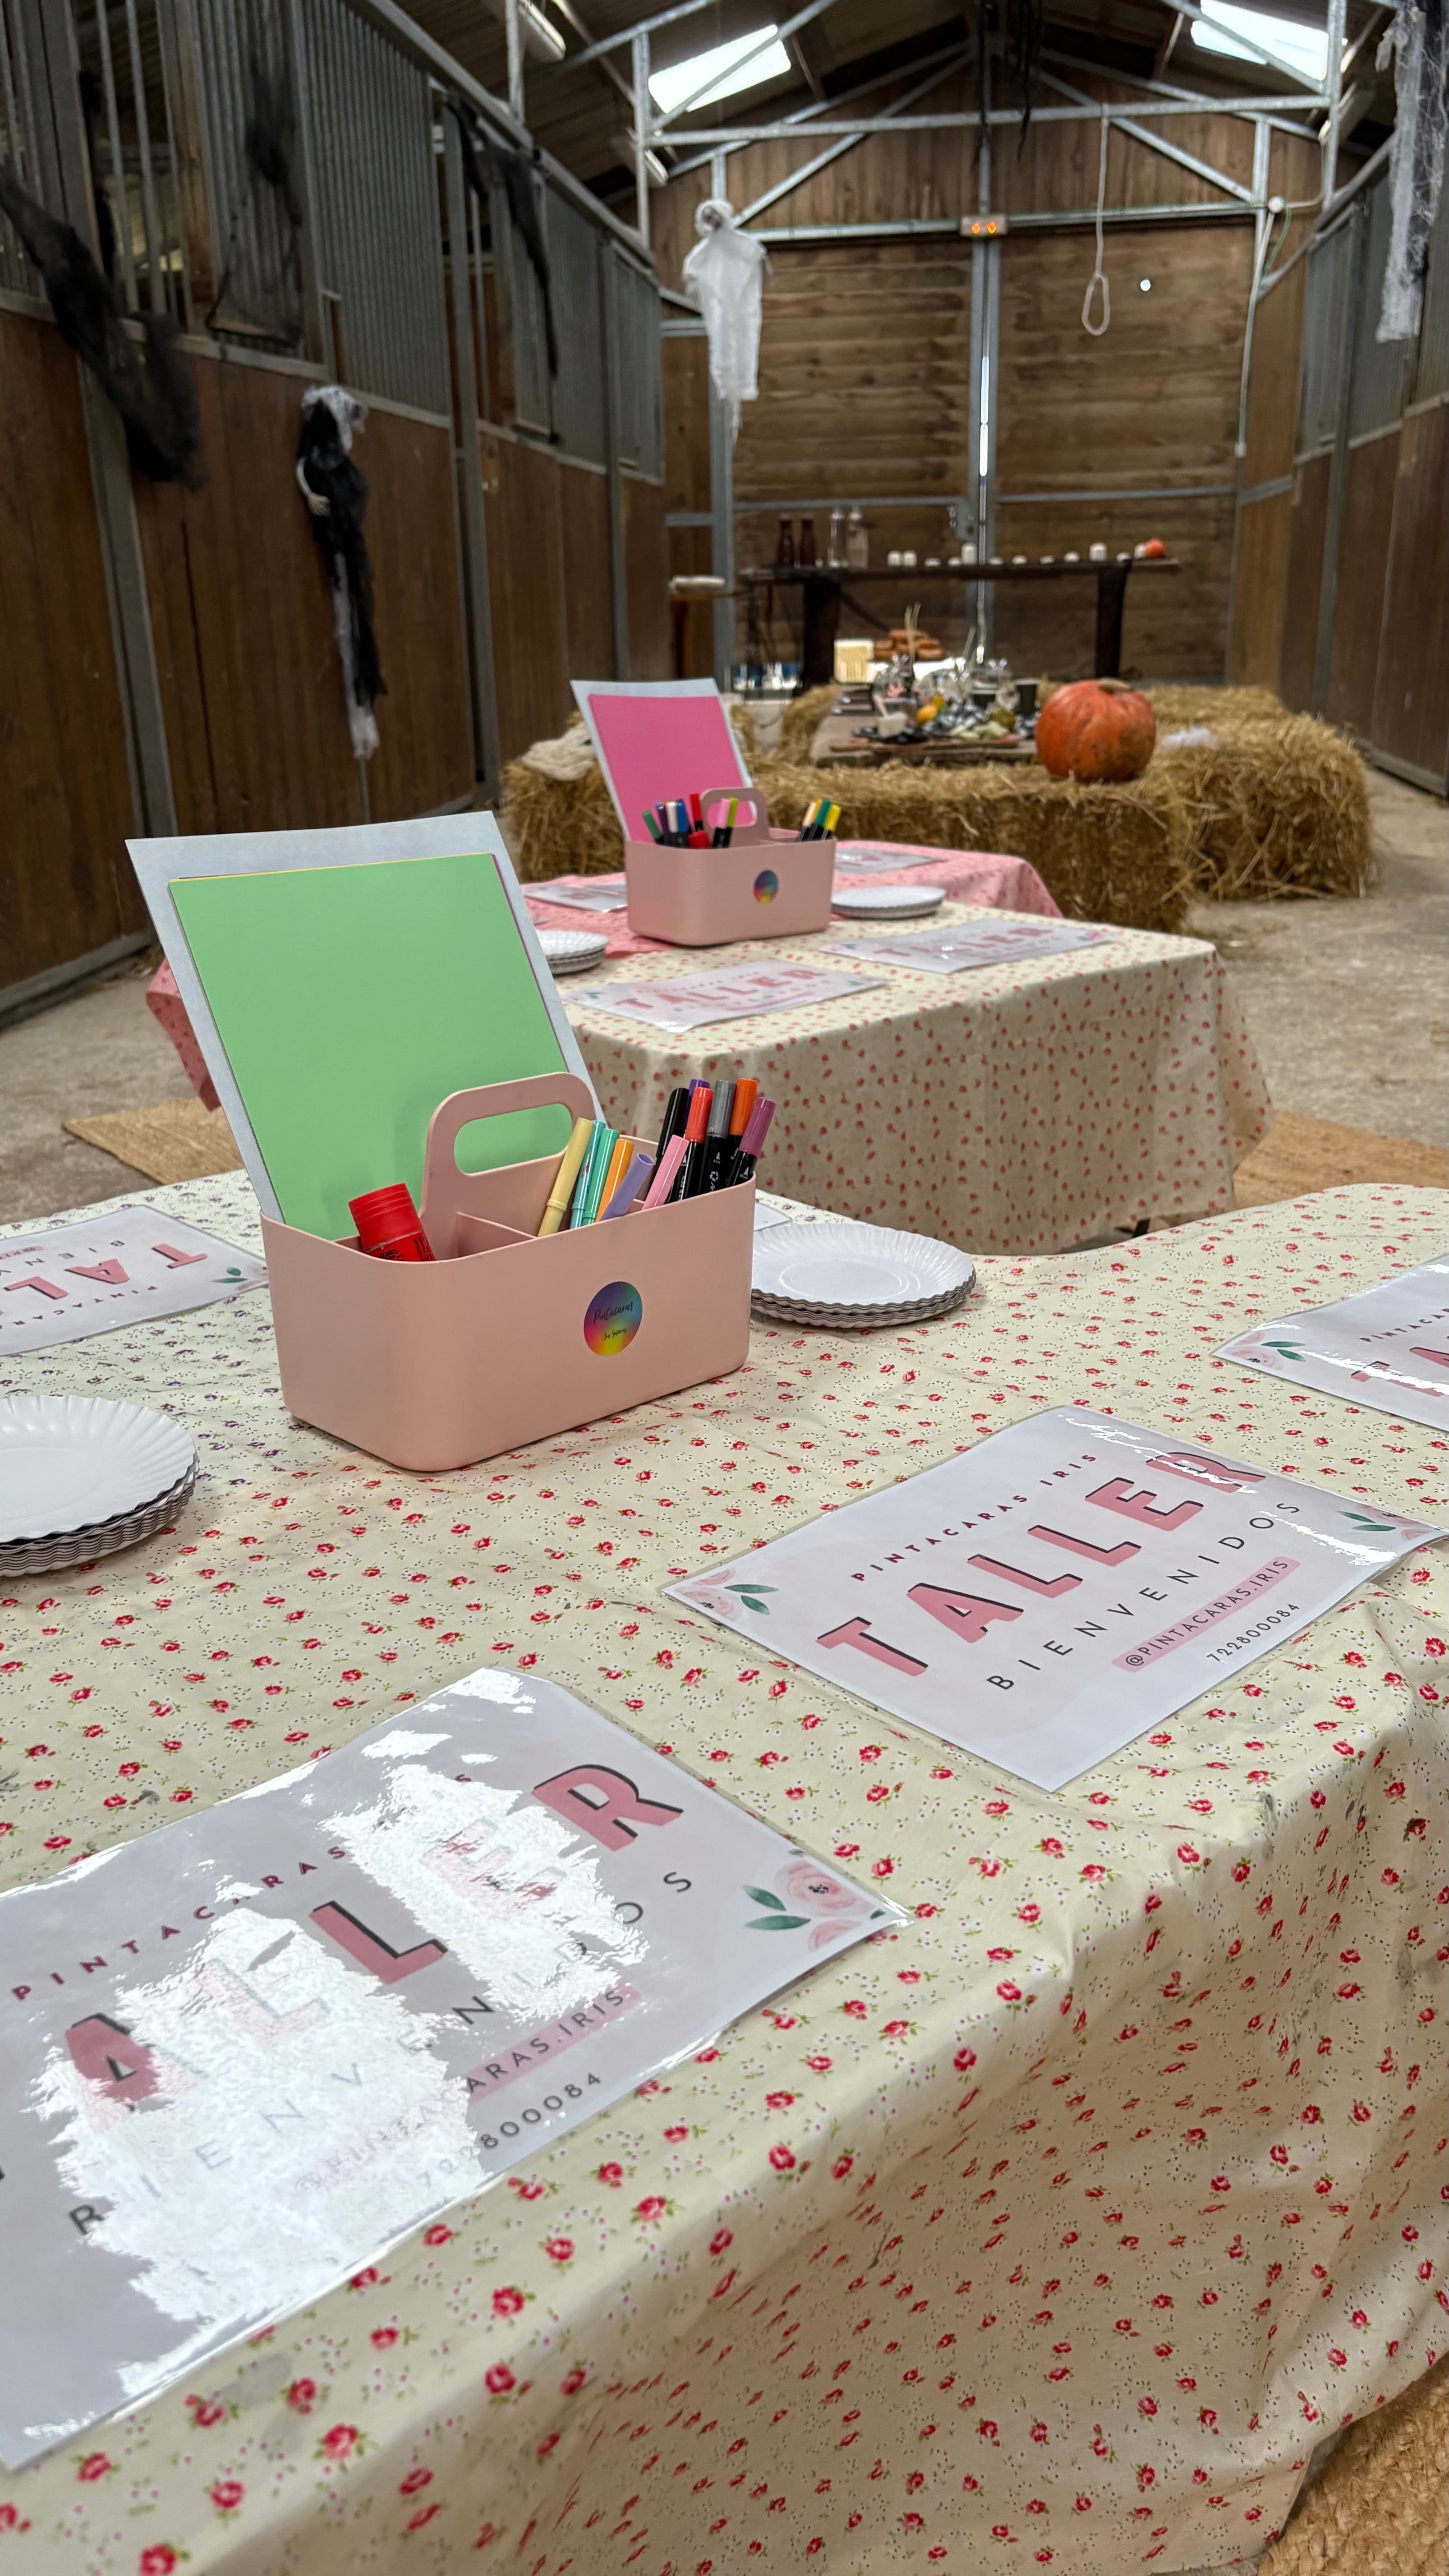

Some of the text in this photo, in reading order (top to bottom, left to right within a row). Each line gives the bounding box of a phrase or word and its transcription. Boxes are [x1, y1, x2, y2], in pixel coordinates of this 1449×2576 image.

[615, 969, 827, 1009] TALLER
[0, 1243, 209, 1316] TAL
[0, 1286, 157, 1329] PINTACAR
[815, 1452, 1266, 1677] TALLER
[851, 1454, 1096, 1581] PINTACARAS IRIS
[986, 1503, 1300, 1690] BIENVENIDOS
[1125, 1560, 1288, 1666] @PINTACARAS.IRIS
[1206, 1603, 1300, 1663] 722800084
[0, 1764, 684, 2181] ALLER
[11, 1846, 345, 2000] PINTACRAS
